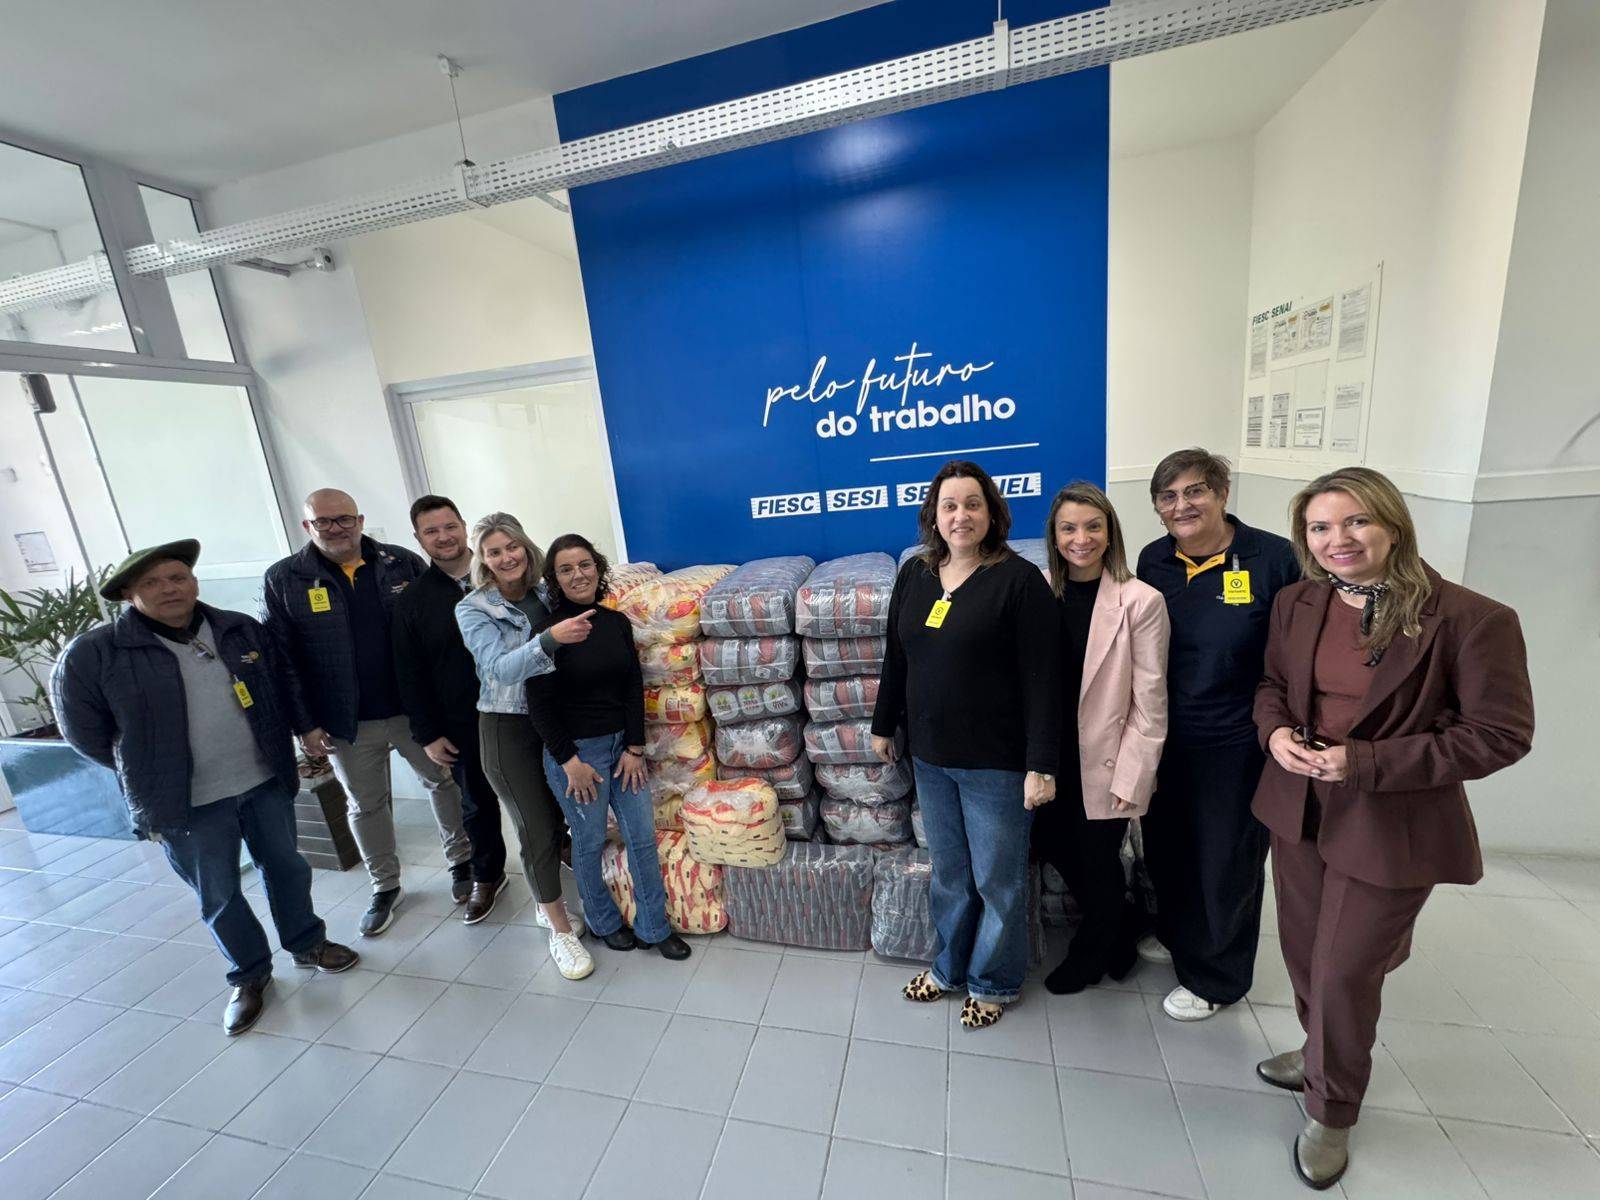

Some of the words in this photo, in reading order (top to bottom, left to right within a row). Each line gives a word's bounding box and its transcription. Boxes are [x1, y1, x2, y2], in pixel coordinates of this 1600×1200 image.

[1252, 310, 1270, 326] FIESC
[1271, 300, 1293, 318] SENAI
[762, 355, 855, 427] pelo
[855, 342, 994, 416] futuro
[816, 411, 857, 438] do
[870, 394, 1016, 432] trabalho
[757, 495, 815, 515] FIESC
[833, 489, 881, 509] SESI
[999, 477, 1035, 495] IEL
